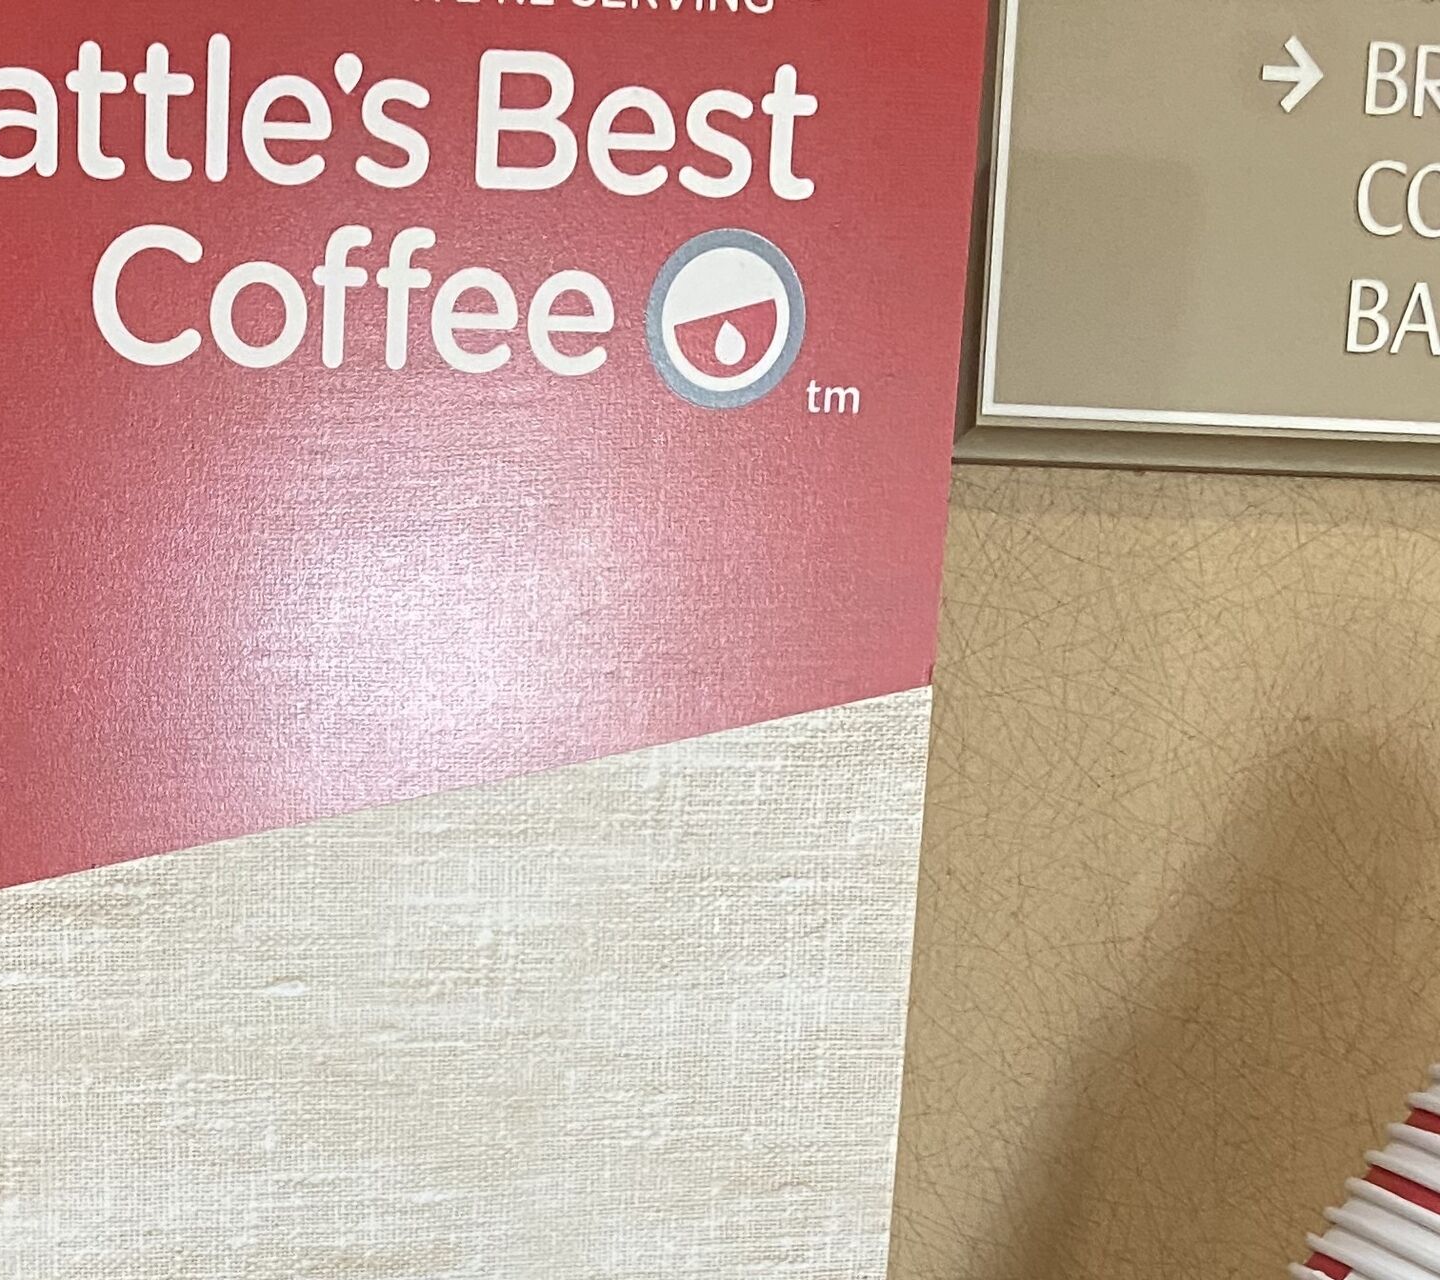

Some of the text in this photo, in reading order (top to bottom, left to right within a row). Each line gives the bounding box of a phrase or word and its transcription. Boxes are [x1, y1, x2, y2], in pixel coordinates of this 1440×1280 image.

[475, 49, 819, 201] Best
[92, 223, 616, 377] Coffee
[806, 379, 862, 416] tm
